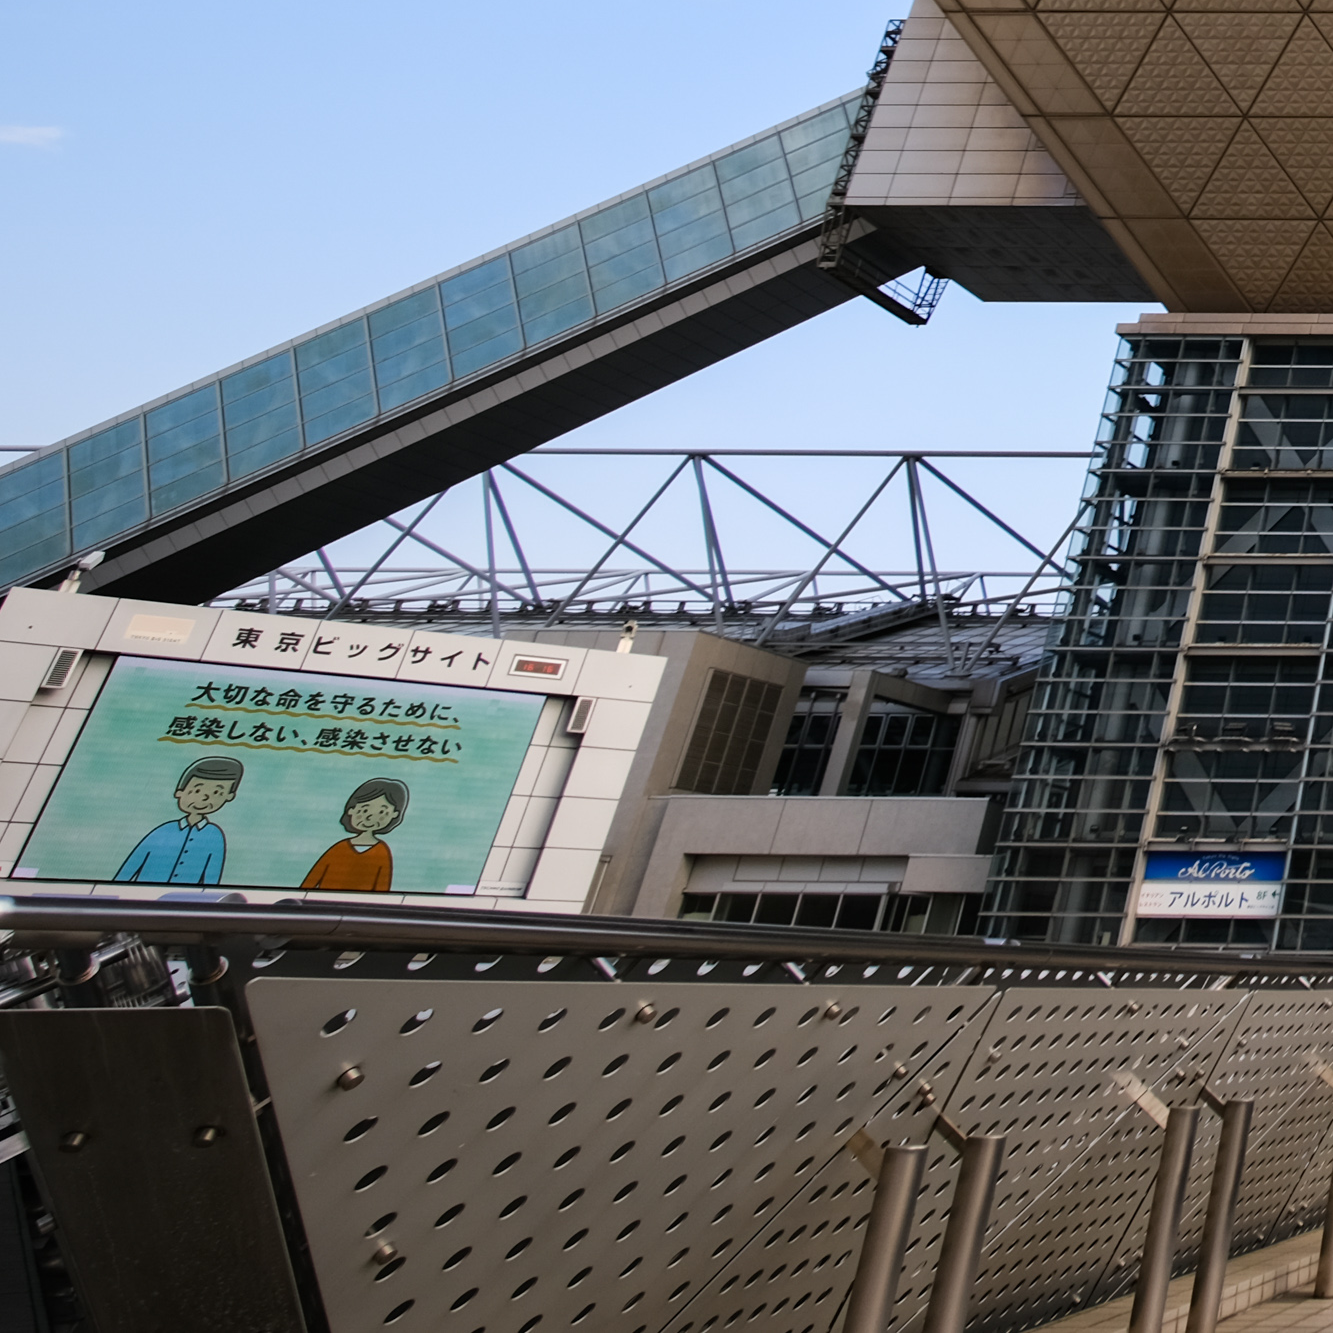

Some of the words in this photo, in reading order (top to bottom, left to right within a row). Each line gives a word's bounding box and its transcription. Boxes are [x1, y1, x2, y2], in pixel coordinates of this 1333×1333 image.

[232, 627, 491, 671] 東京ビッグサイト
[191, 681, 460, 724] 大切な命を守るために、
[165, 715, 462, 756] 感染しない、感染させない
[1168, 890, 1249, 909] アルポルト
[1256, 890, 1269, 901] 8F
